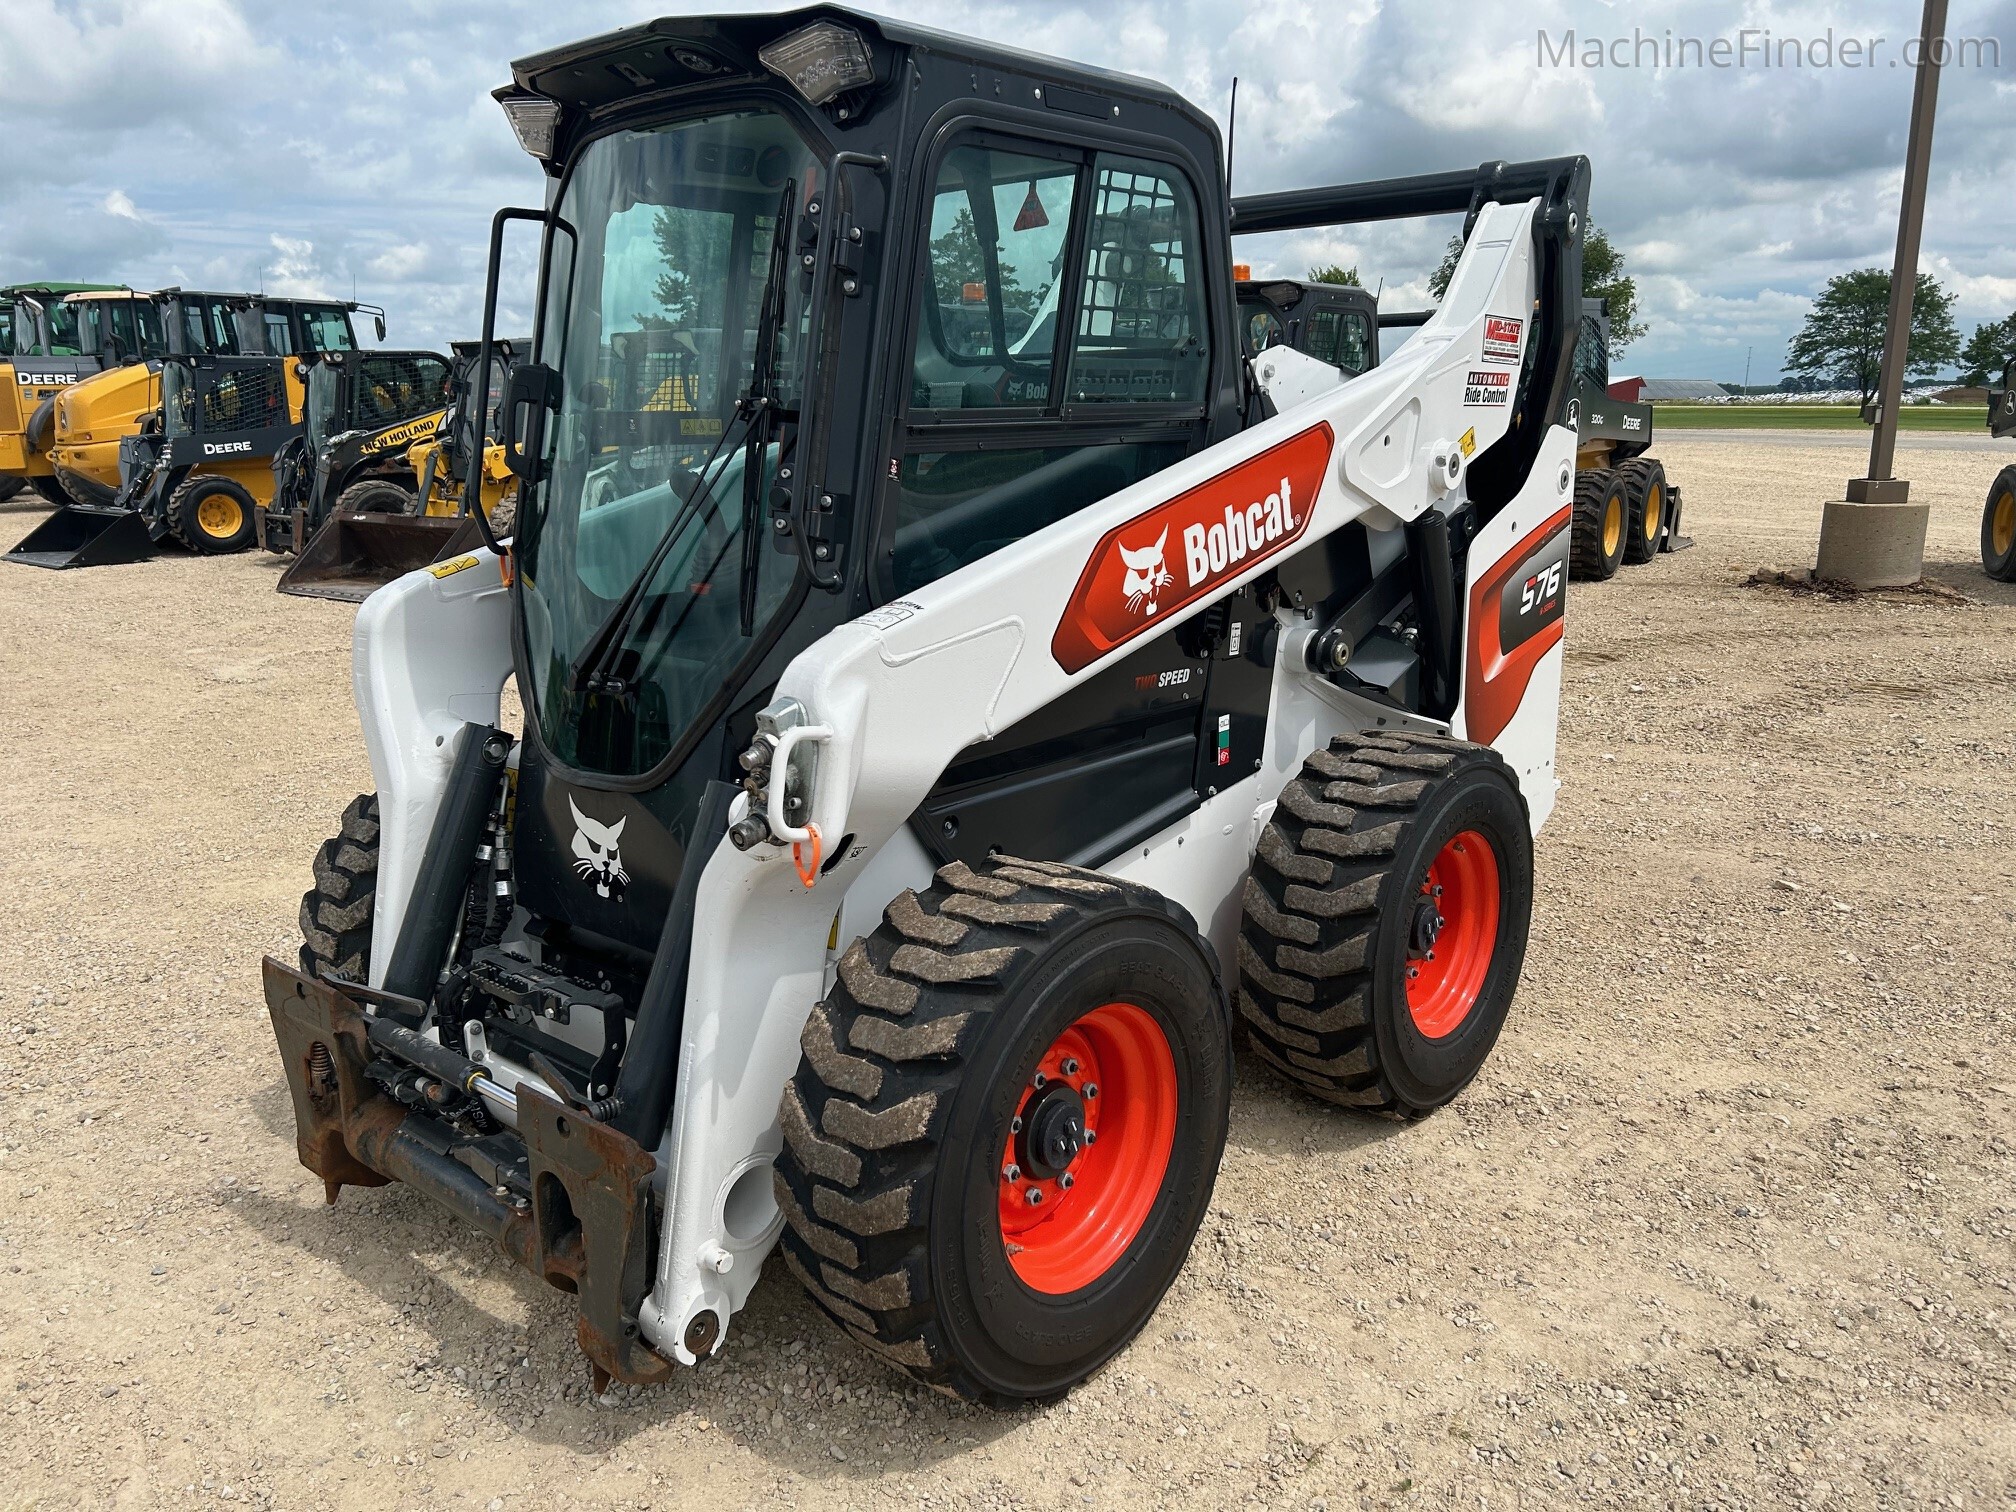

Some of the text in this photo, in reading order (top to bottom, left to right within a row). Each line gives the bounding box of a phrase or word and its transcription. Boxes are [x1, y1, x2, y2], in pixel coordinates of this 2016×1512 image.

[17, 372, 78, 385] DEERE
[1468, 374, 1509, 386] AUTOMATIC
[1464, 387, 1508, 403] Ride Control
[1622, 415, 1641, 431] DEERE
[364, 420, 434, 452] NEW HOLLAND
[203, 440, 253, 456] DEERE
[1183, 476, 1295, 588] Bobcat
[1520, 559, 1562, 616] S76
[1135, 668, 1191, 691] TWO SPEED
